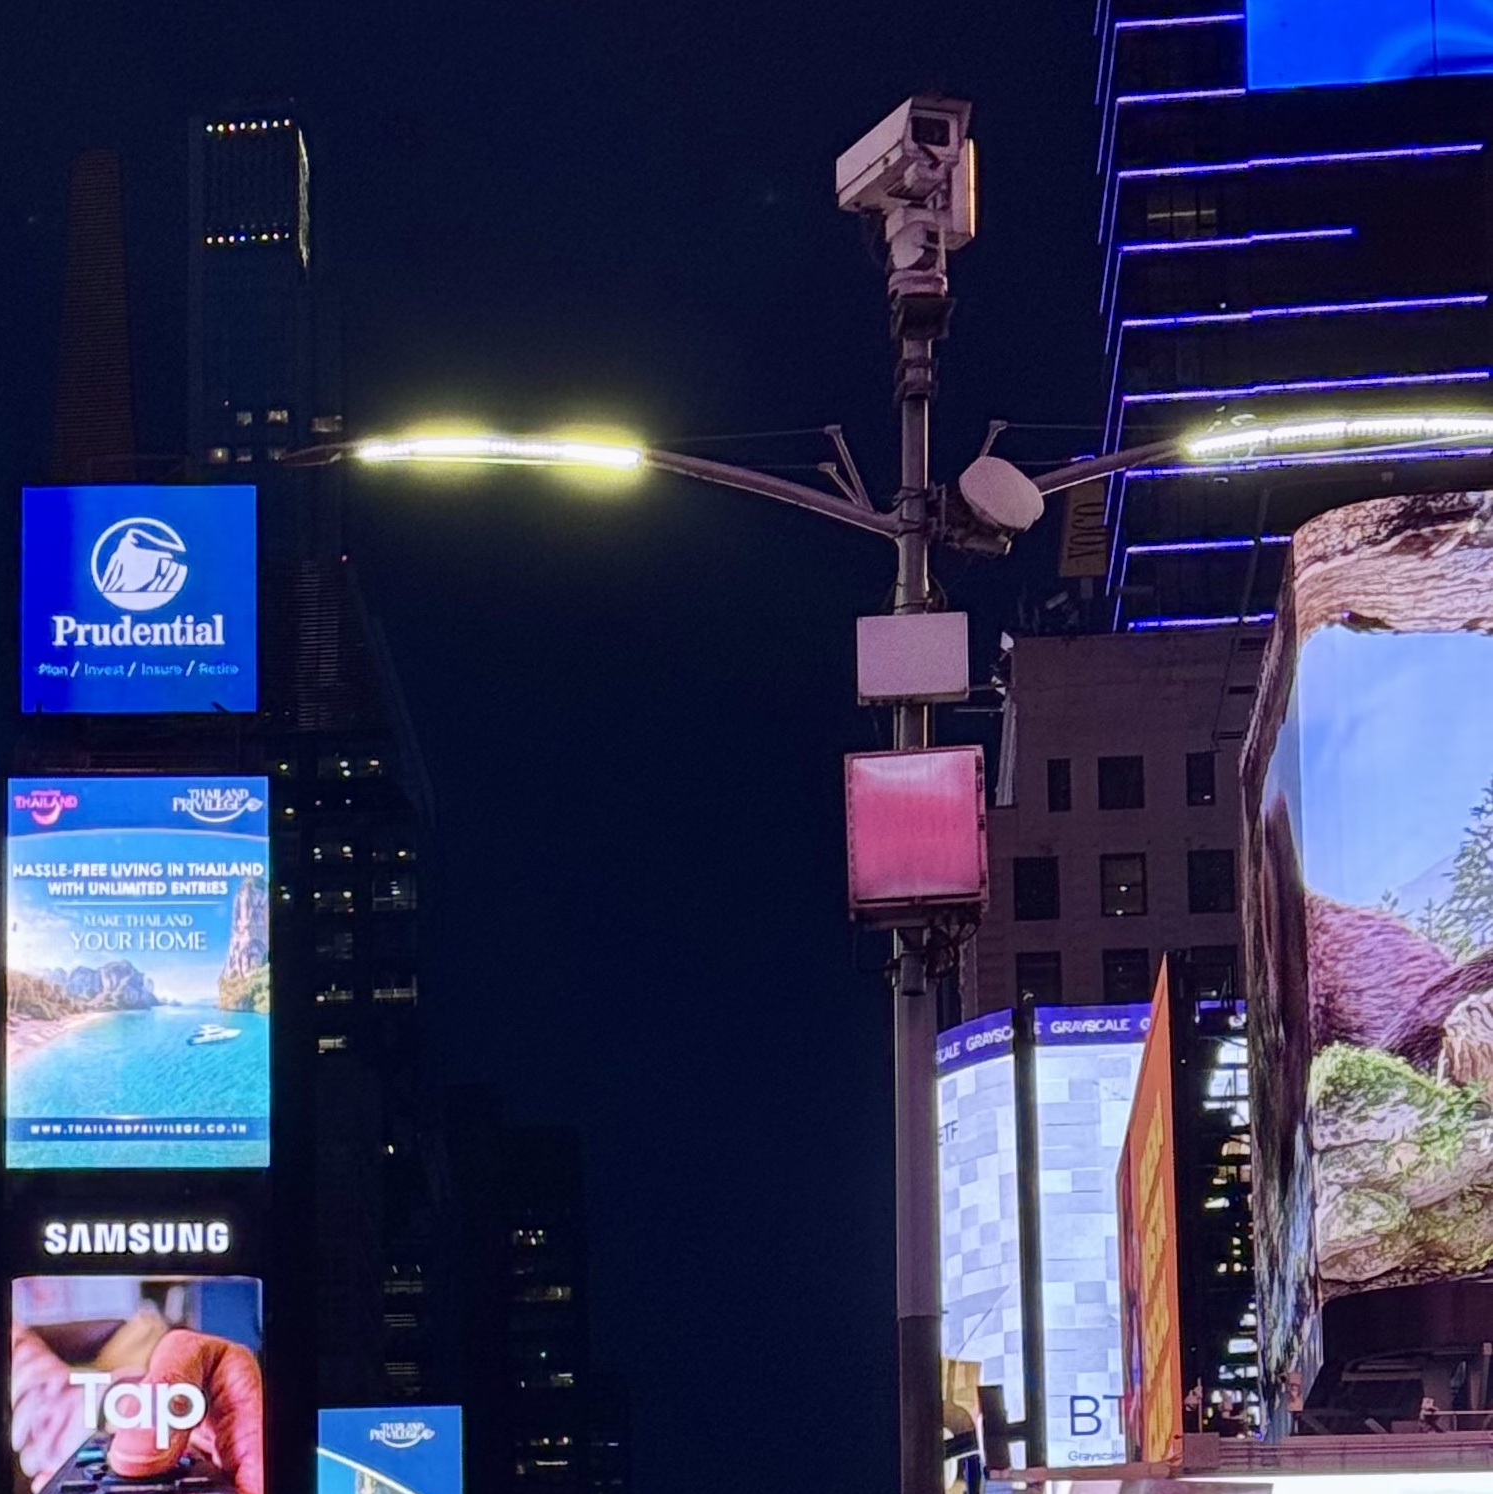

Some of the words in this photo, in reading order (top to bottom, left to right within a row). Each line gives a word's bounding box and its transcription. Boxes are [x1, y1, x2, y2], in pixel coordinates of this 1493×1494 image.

[52, 614, 225, 646] Prudential
[38, 662, 68, 677] Plan
[13, 862, 108, 879] HASSLE-FREE
[111, 863, 163, 877] LIVING
[168, 863, 183, 877] IN
[188, 862, 264, 877] THAILAND
[48, 881, 84, 896] WITH
[88, 881, 166, 896] UNLIMITED
[171, 881, 228, 895] ENTRIES
[70, 931, 132, 950] YOUR
[139, 930, 206, 950] HOME
[1050, 1018, 1131, 1034] GRAYSCALE
[44, 1222, 230, 1255] SAMSUNG
[69, 1372, 207, 1450] Tap
